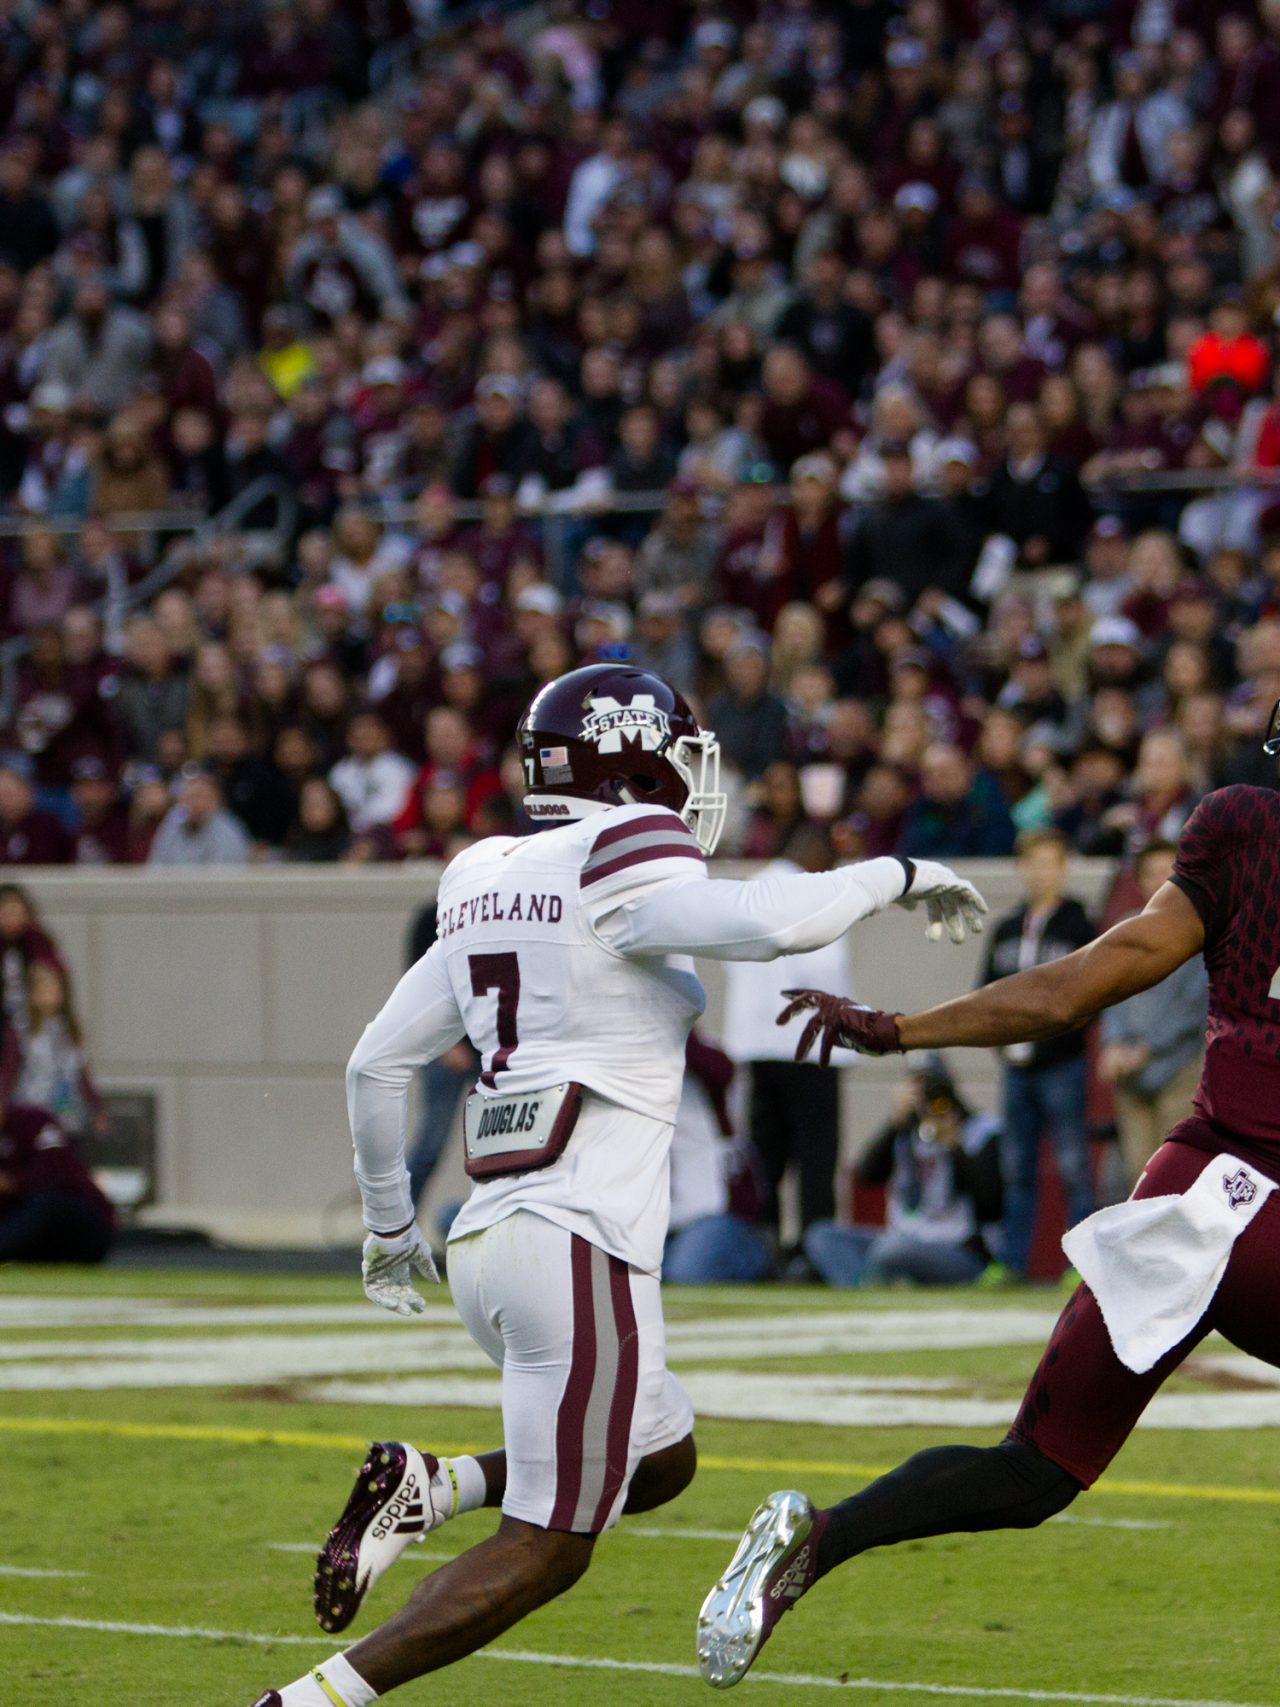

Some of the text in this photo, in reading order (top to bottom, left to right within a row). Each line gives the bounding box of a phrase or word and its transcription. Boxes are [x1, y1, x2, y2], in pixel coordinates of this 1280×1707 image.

[599, 709, 656, 732] STATE
[442, 892, 563, 939] CLEVELAND
[468, 952, 520, 1091] 7
[477, 1102, 539, 1140] DOUGLAS
[372, 1473, 416, 1540] adidas
[770, 1545, 810, 1600] adidas
